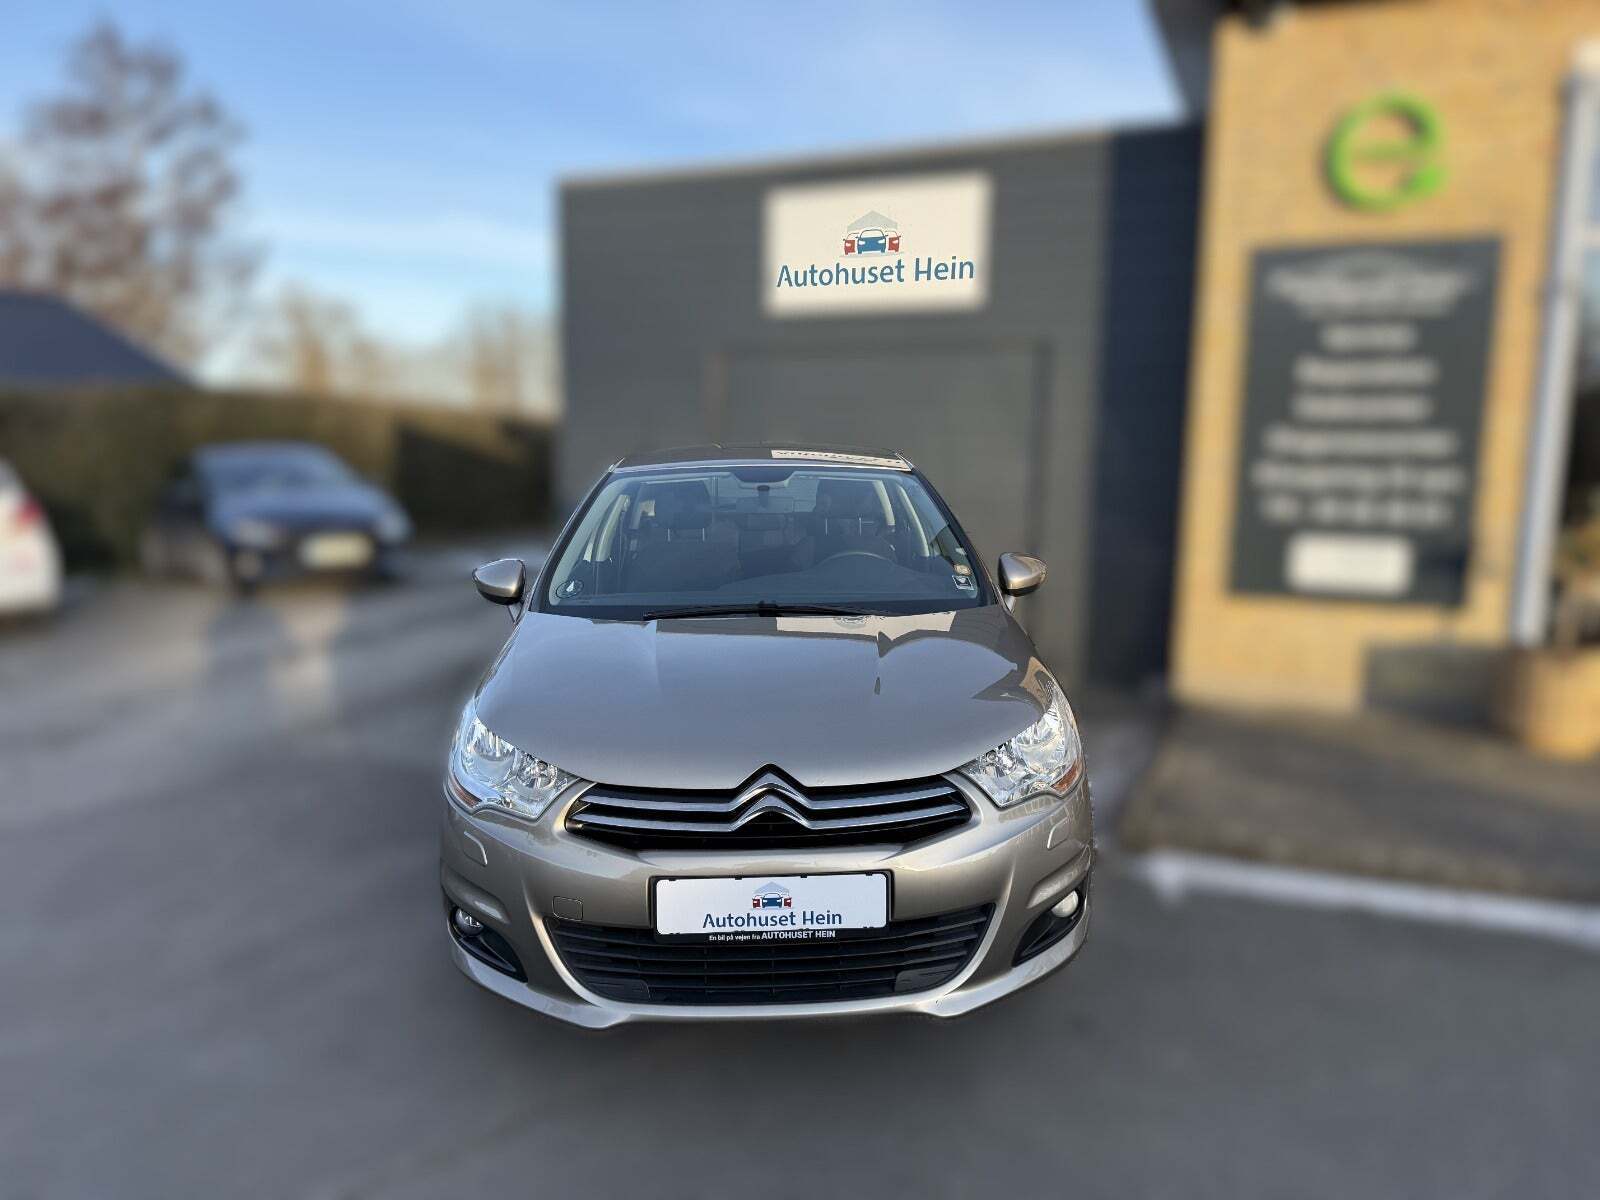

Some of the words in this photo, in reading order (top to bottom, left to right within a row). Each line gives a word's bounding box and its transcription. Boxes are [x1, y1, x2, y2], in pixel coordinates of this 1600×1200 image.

[776, 259, 905, 288] Autohuset
[914, 255, 975, 281] Hein
[702, 912, 796, 929] Autohuset
[802, 910, 842, 925] Hein
[761, 930, 814, 940] AUTOHUSET
[815, 930, 836, 938] HEIN
